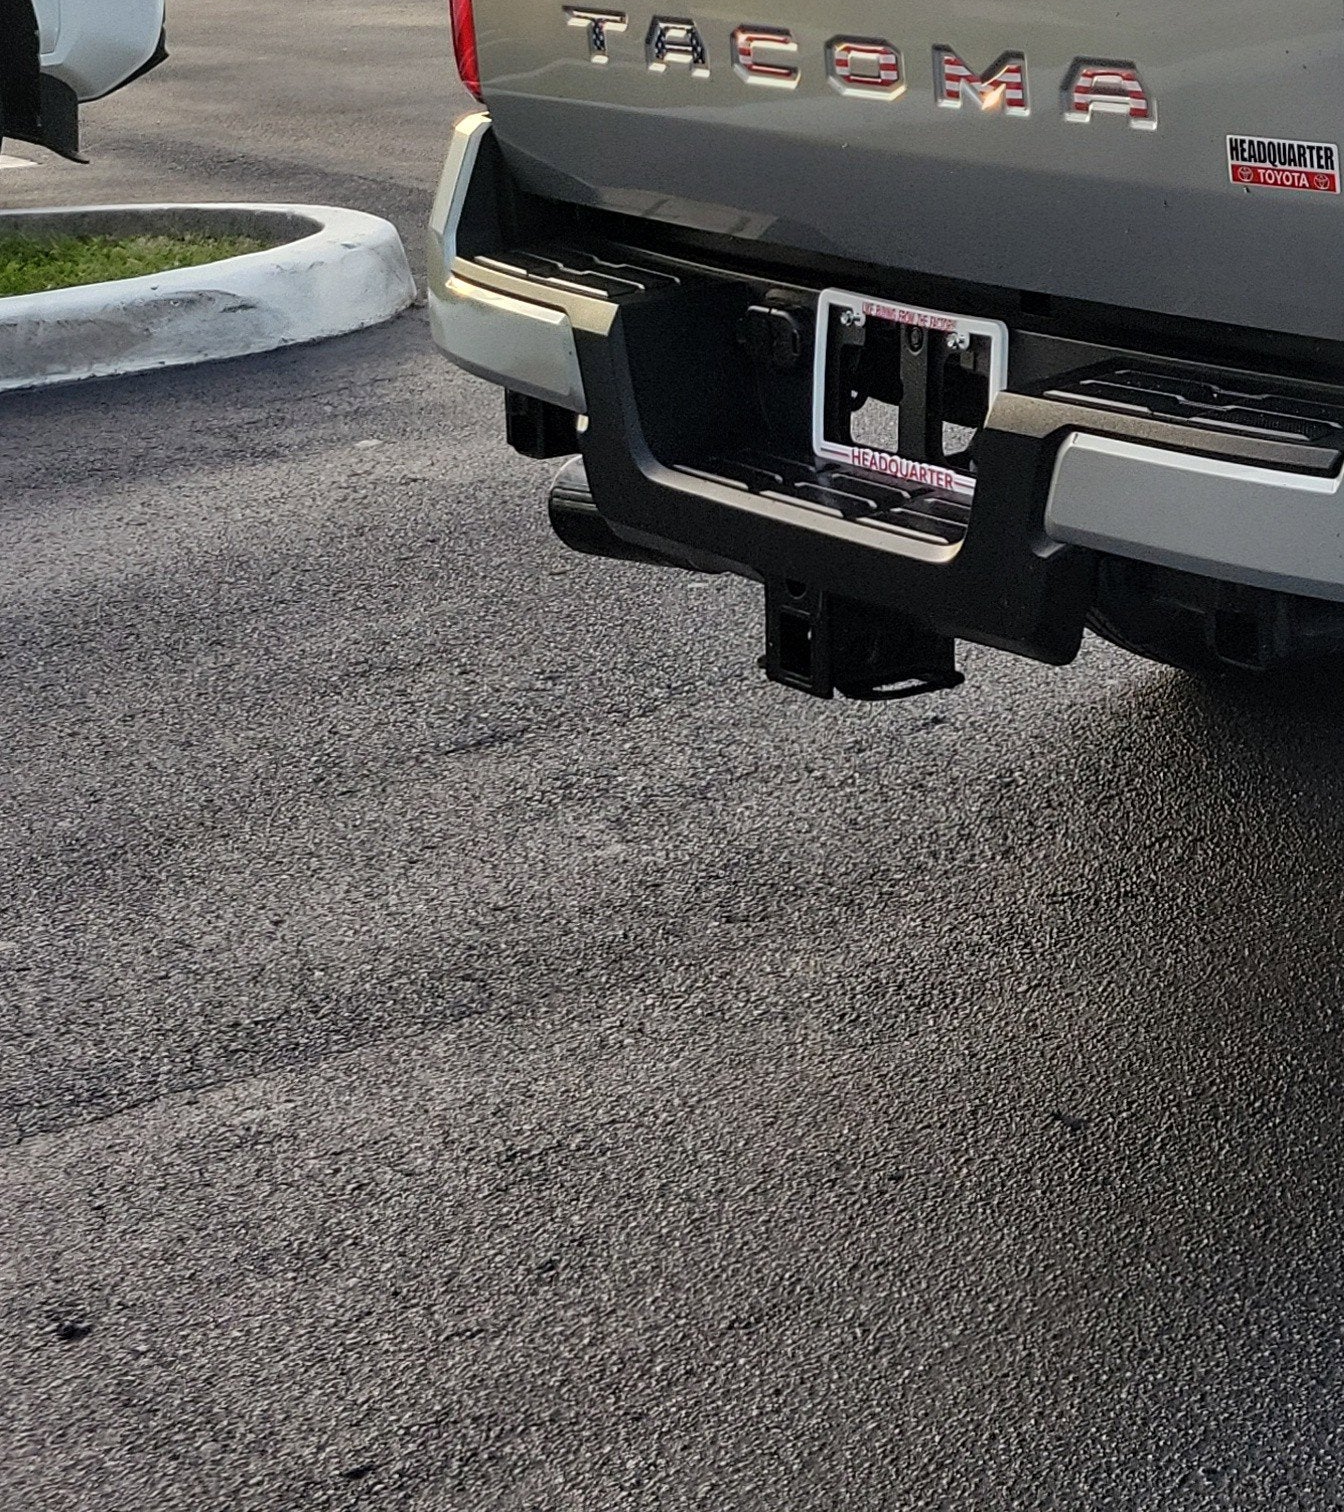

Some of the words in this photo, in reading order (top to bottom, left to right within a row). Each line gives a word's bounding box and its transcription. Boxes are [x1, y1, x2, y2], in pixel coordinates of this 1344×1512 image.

[562, 4, 1158, 131] TACOMA
[1228, 137, 1335, 171] HEADQUARTER
[1257, 168, 1310, 188] TOYOTA
[851, 448, 954, 490] HEADQUARTER
